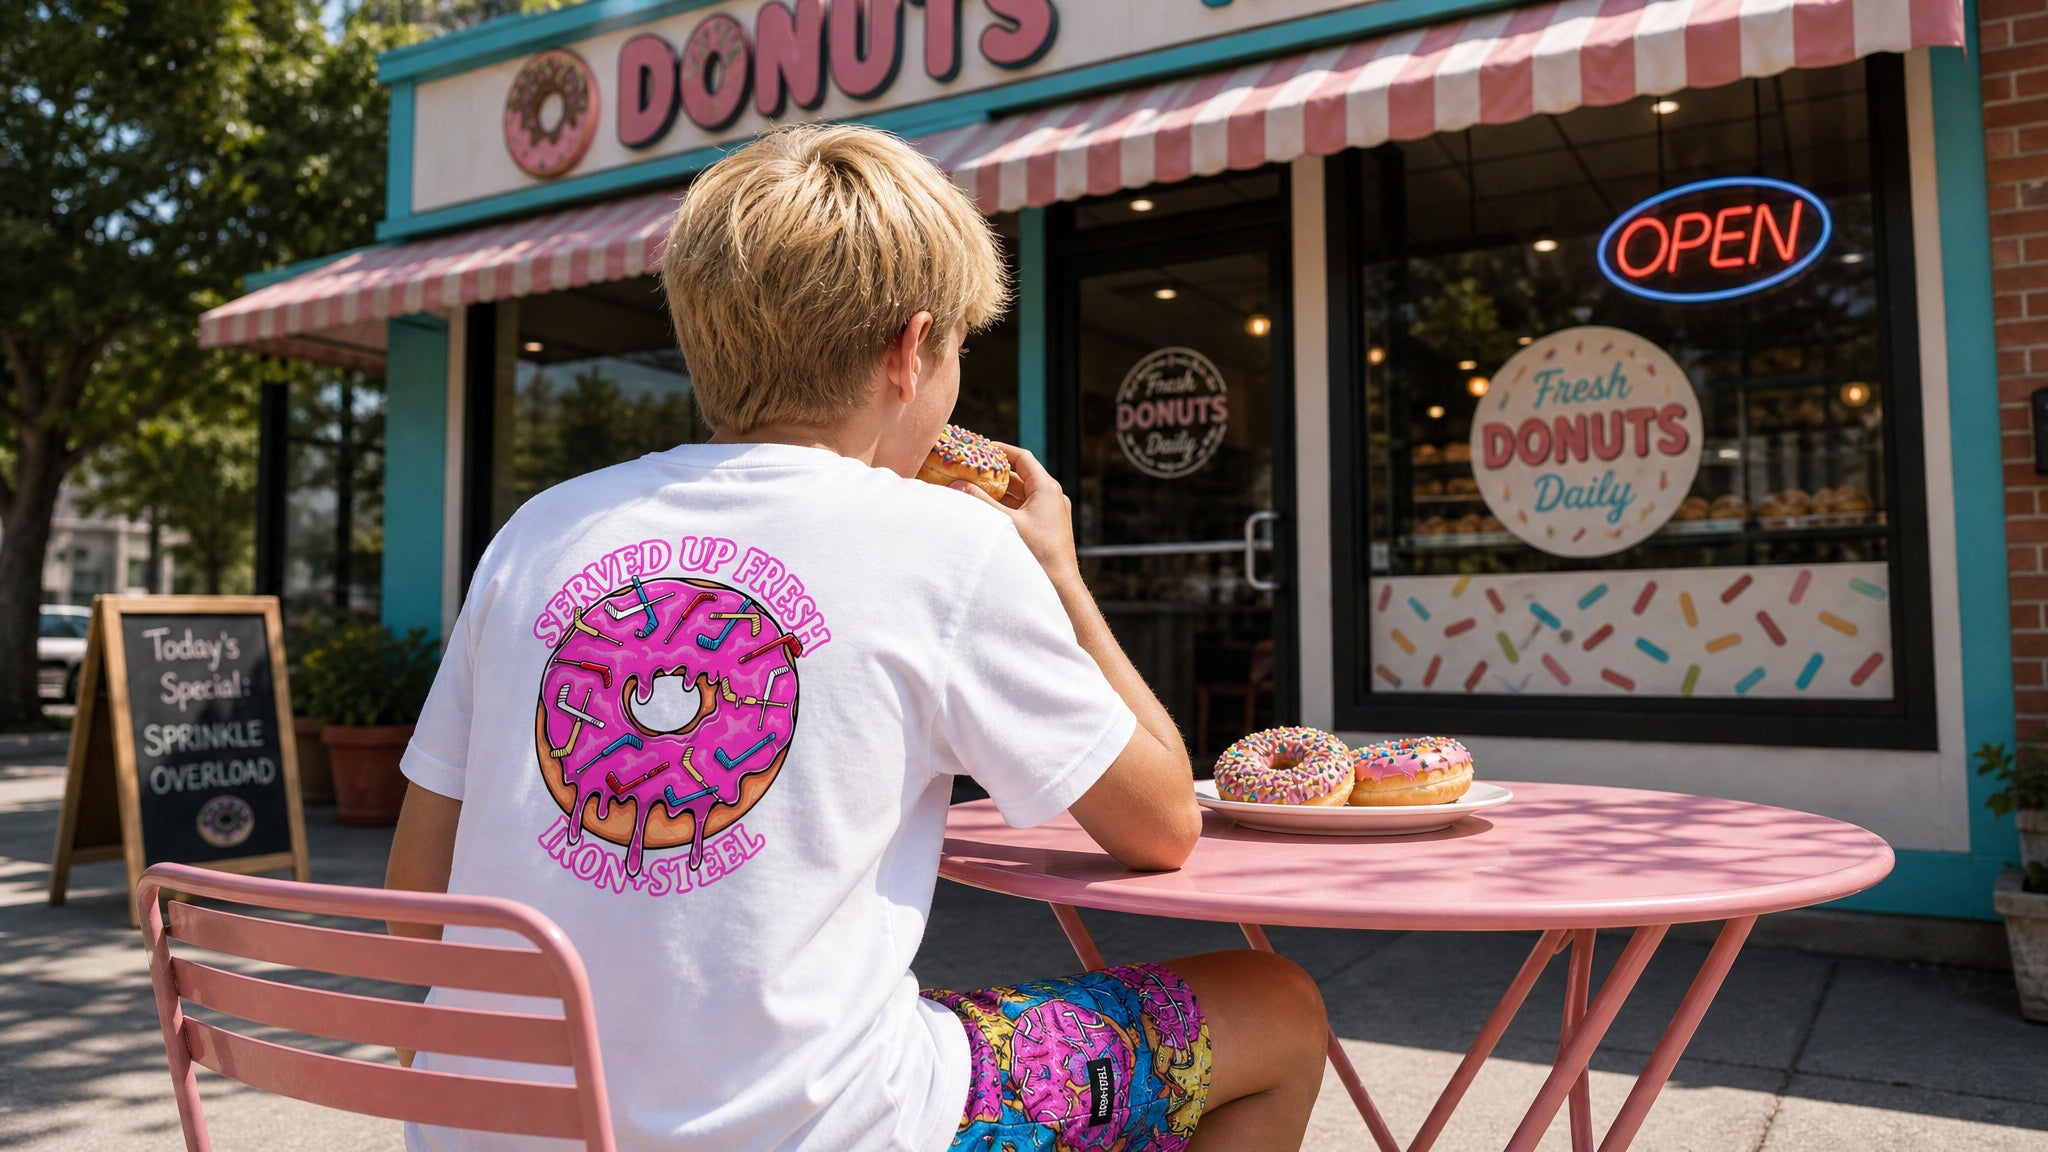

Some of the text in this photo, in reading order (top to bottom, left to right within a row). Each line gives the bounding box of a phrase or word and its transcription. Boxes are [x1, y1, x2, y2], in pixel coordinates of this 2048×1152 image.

[617, 0, 1058, 149] DONUTS
[1616, 199, 1803, 278] OPEN
[1145, 368, 1198, 398] Fresh
[1532, 361, 1632, 410] Fresh
[1116, 393, 1229, 432] DONUTS
[1145, 430, 1197, 461] Daily
[1482, 403, 1690, 471] DONUTS
[1534, 469, 1638, 525] Daily
[533, 536, 831, 657] SERVED UP FRESH
[141, 626, 241, 671] Today's
[160, 668, 251, 713] Special:
[143, 718, 265, 757] SPRINKLE
[150, 756, 276, 795] OVERLOAD
